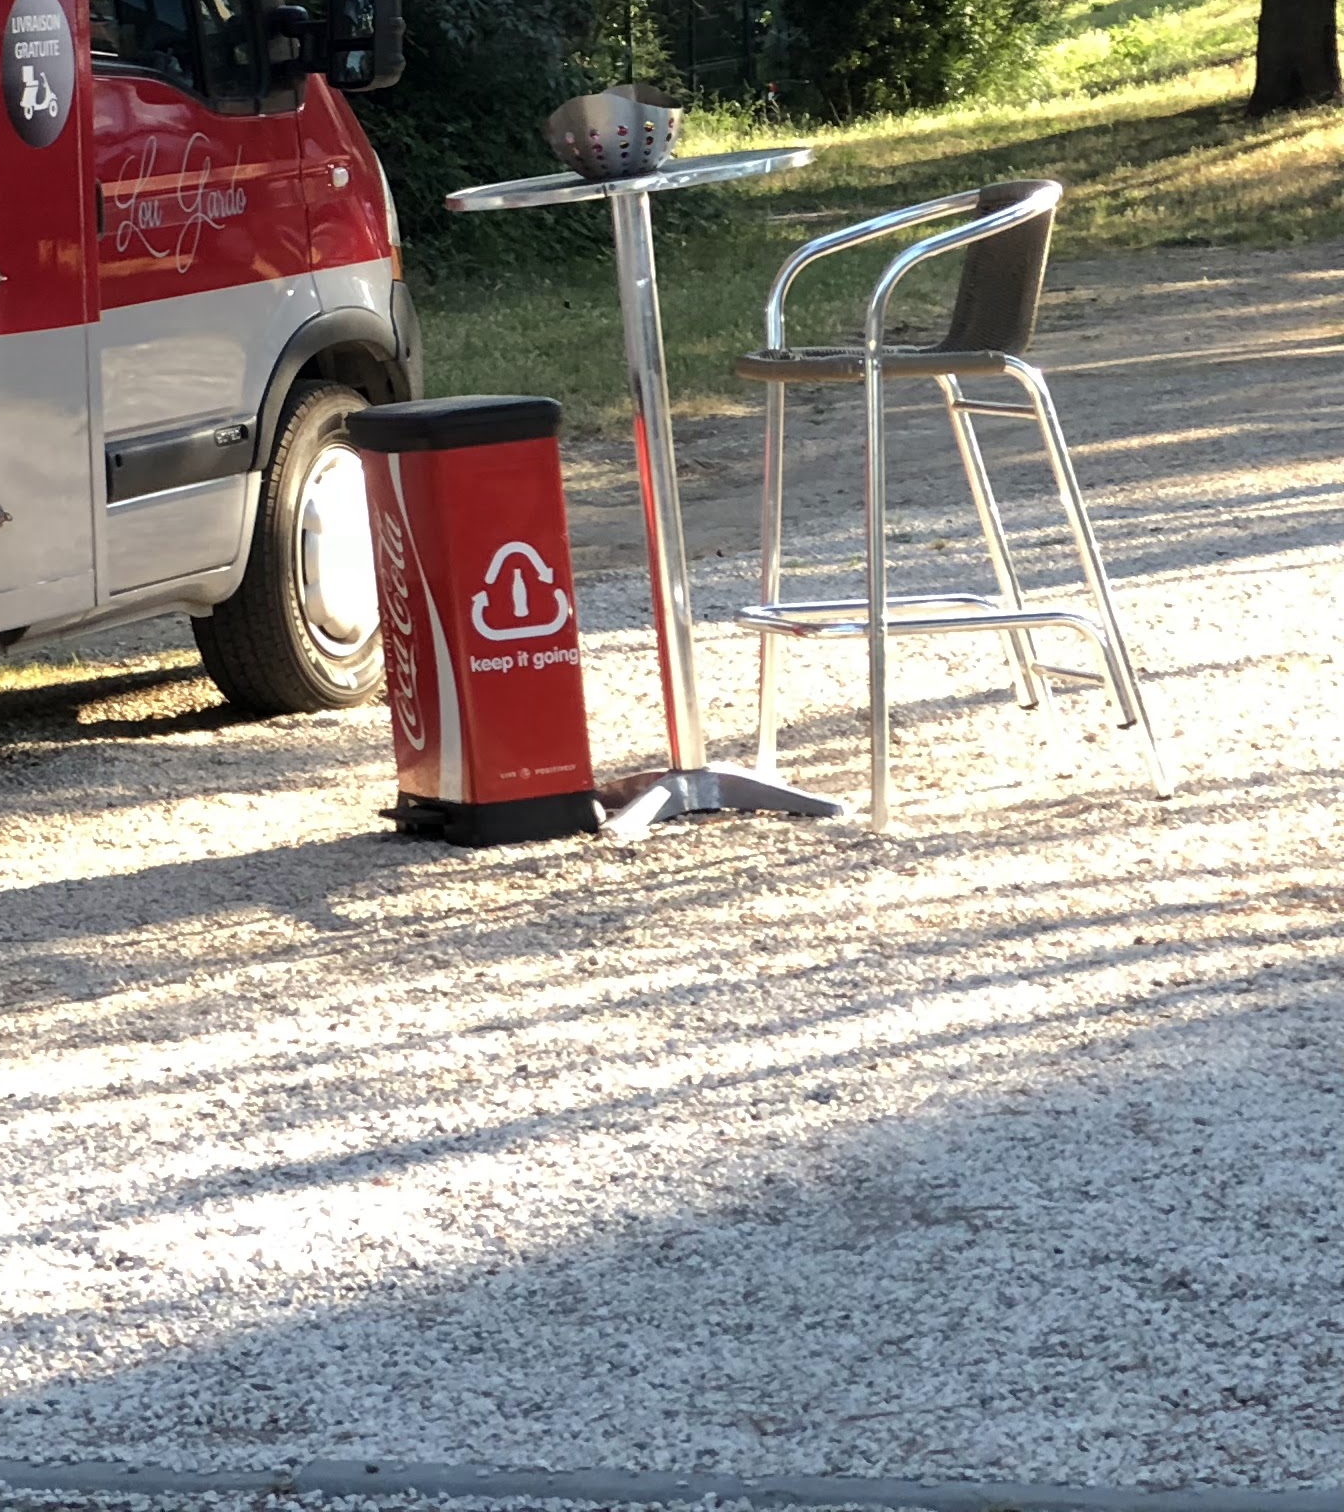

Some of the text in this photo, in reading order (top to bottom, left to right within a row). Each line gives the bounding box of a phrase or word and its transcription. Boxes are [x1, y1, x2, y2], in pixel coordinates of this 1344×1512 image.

[12, 14, 61, 34] LIVRAISON
[14, 40, 60, 59] GRATUITE
[115, 132, 246, 274] Lou Gardo
[470, 645, 578, 674] keep it going
